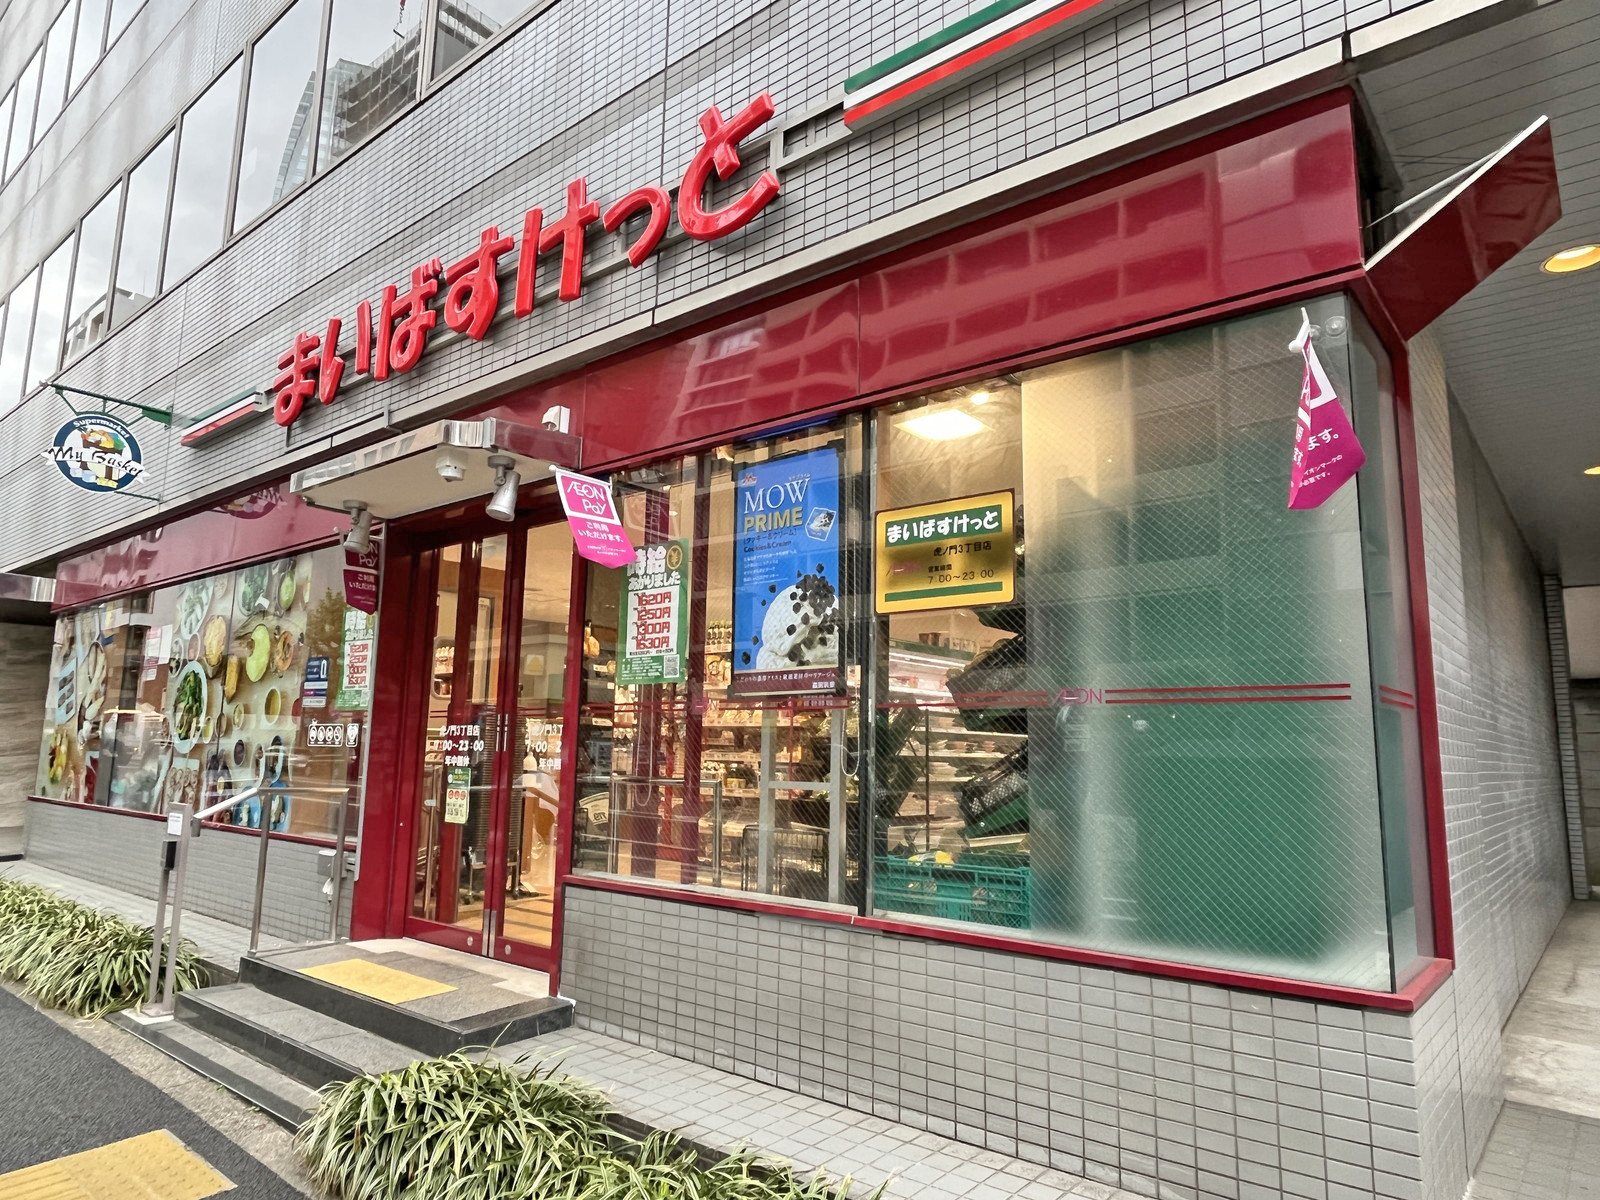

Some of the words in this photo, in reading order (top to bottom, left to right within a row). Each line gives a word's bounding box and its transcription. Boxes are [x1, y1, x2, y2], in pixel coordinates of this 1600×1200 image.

[273, 92, 780, 427] まいばすけっと
[48, 446, 83, 463] My
[744, 478, 811, 514] MOW
[582, 498, 607, 515] Pay
[744, 506, 803, 535] PRIME
[887, 510, 999, 544] まいばすけっと
[933, 540, 992, 557] 虎ノ門3丁目店
[358, 553, 378, 567] Pay
[628, 570, 681, 591] あがりました
[637, 591, 672, 606] 1620円
[636, 606, 671, 621] 1250円
[635, 621, 671, 635] 1300円
